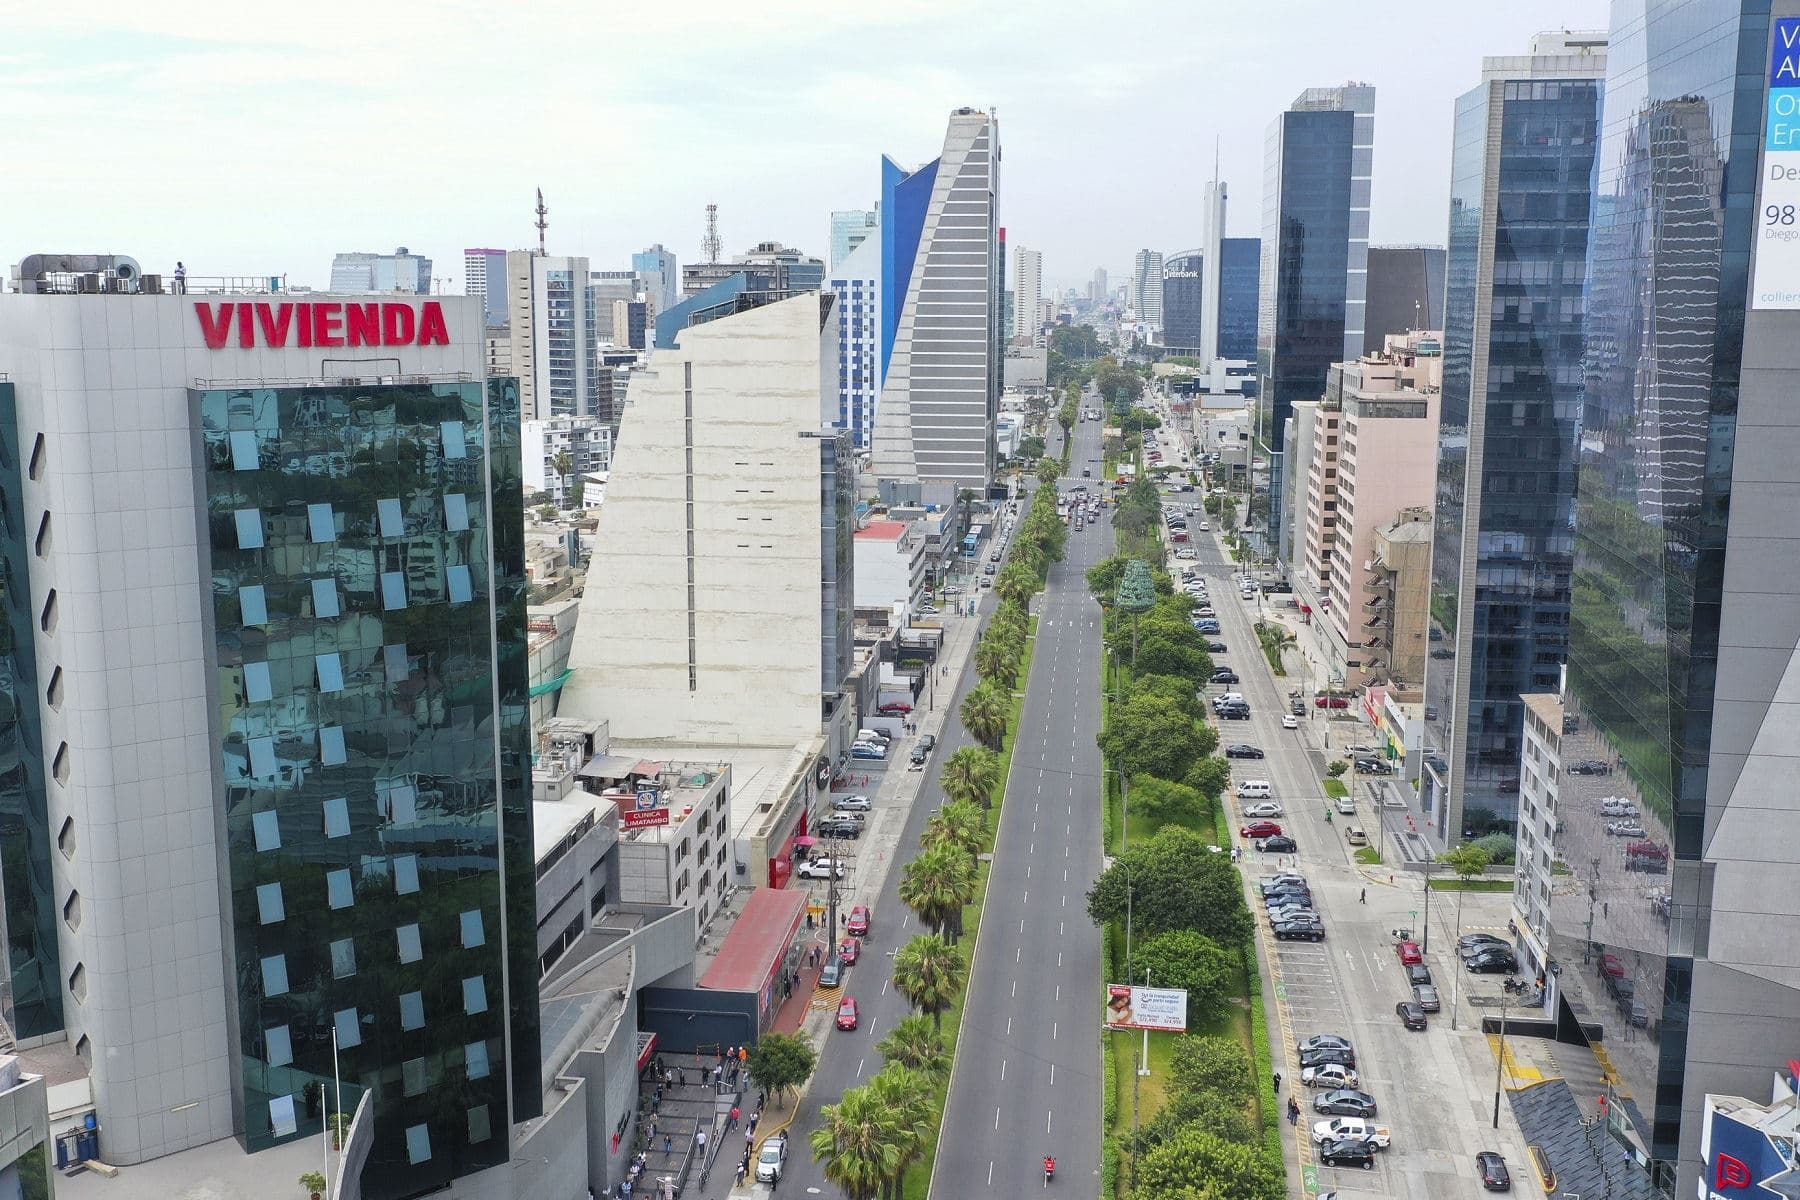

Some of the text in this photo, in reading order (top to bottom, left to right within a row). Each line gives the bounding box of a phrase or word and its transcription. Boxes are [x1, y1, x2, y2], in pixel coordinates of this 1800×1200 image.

[1780, 25, 1800, 49] V
[1770, 164, 1800, 181] De
[1766, 205, 1800, 226] 98
[194, 301, 450, 350] VIVIENDA
